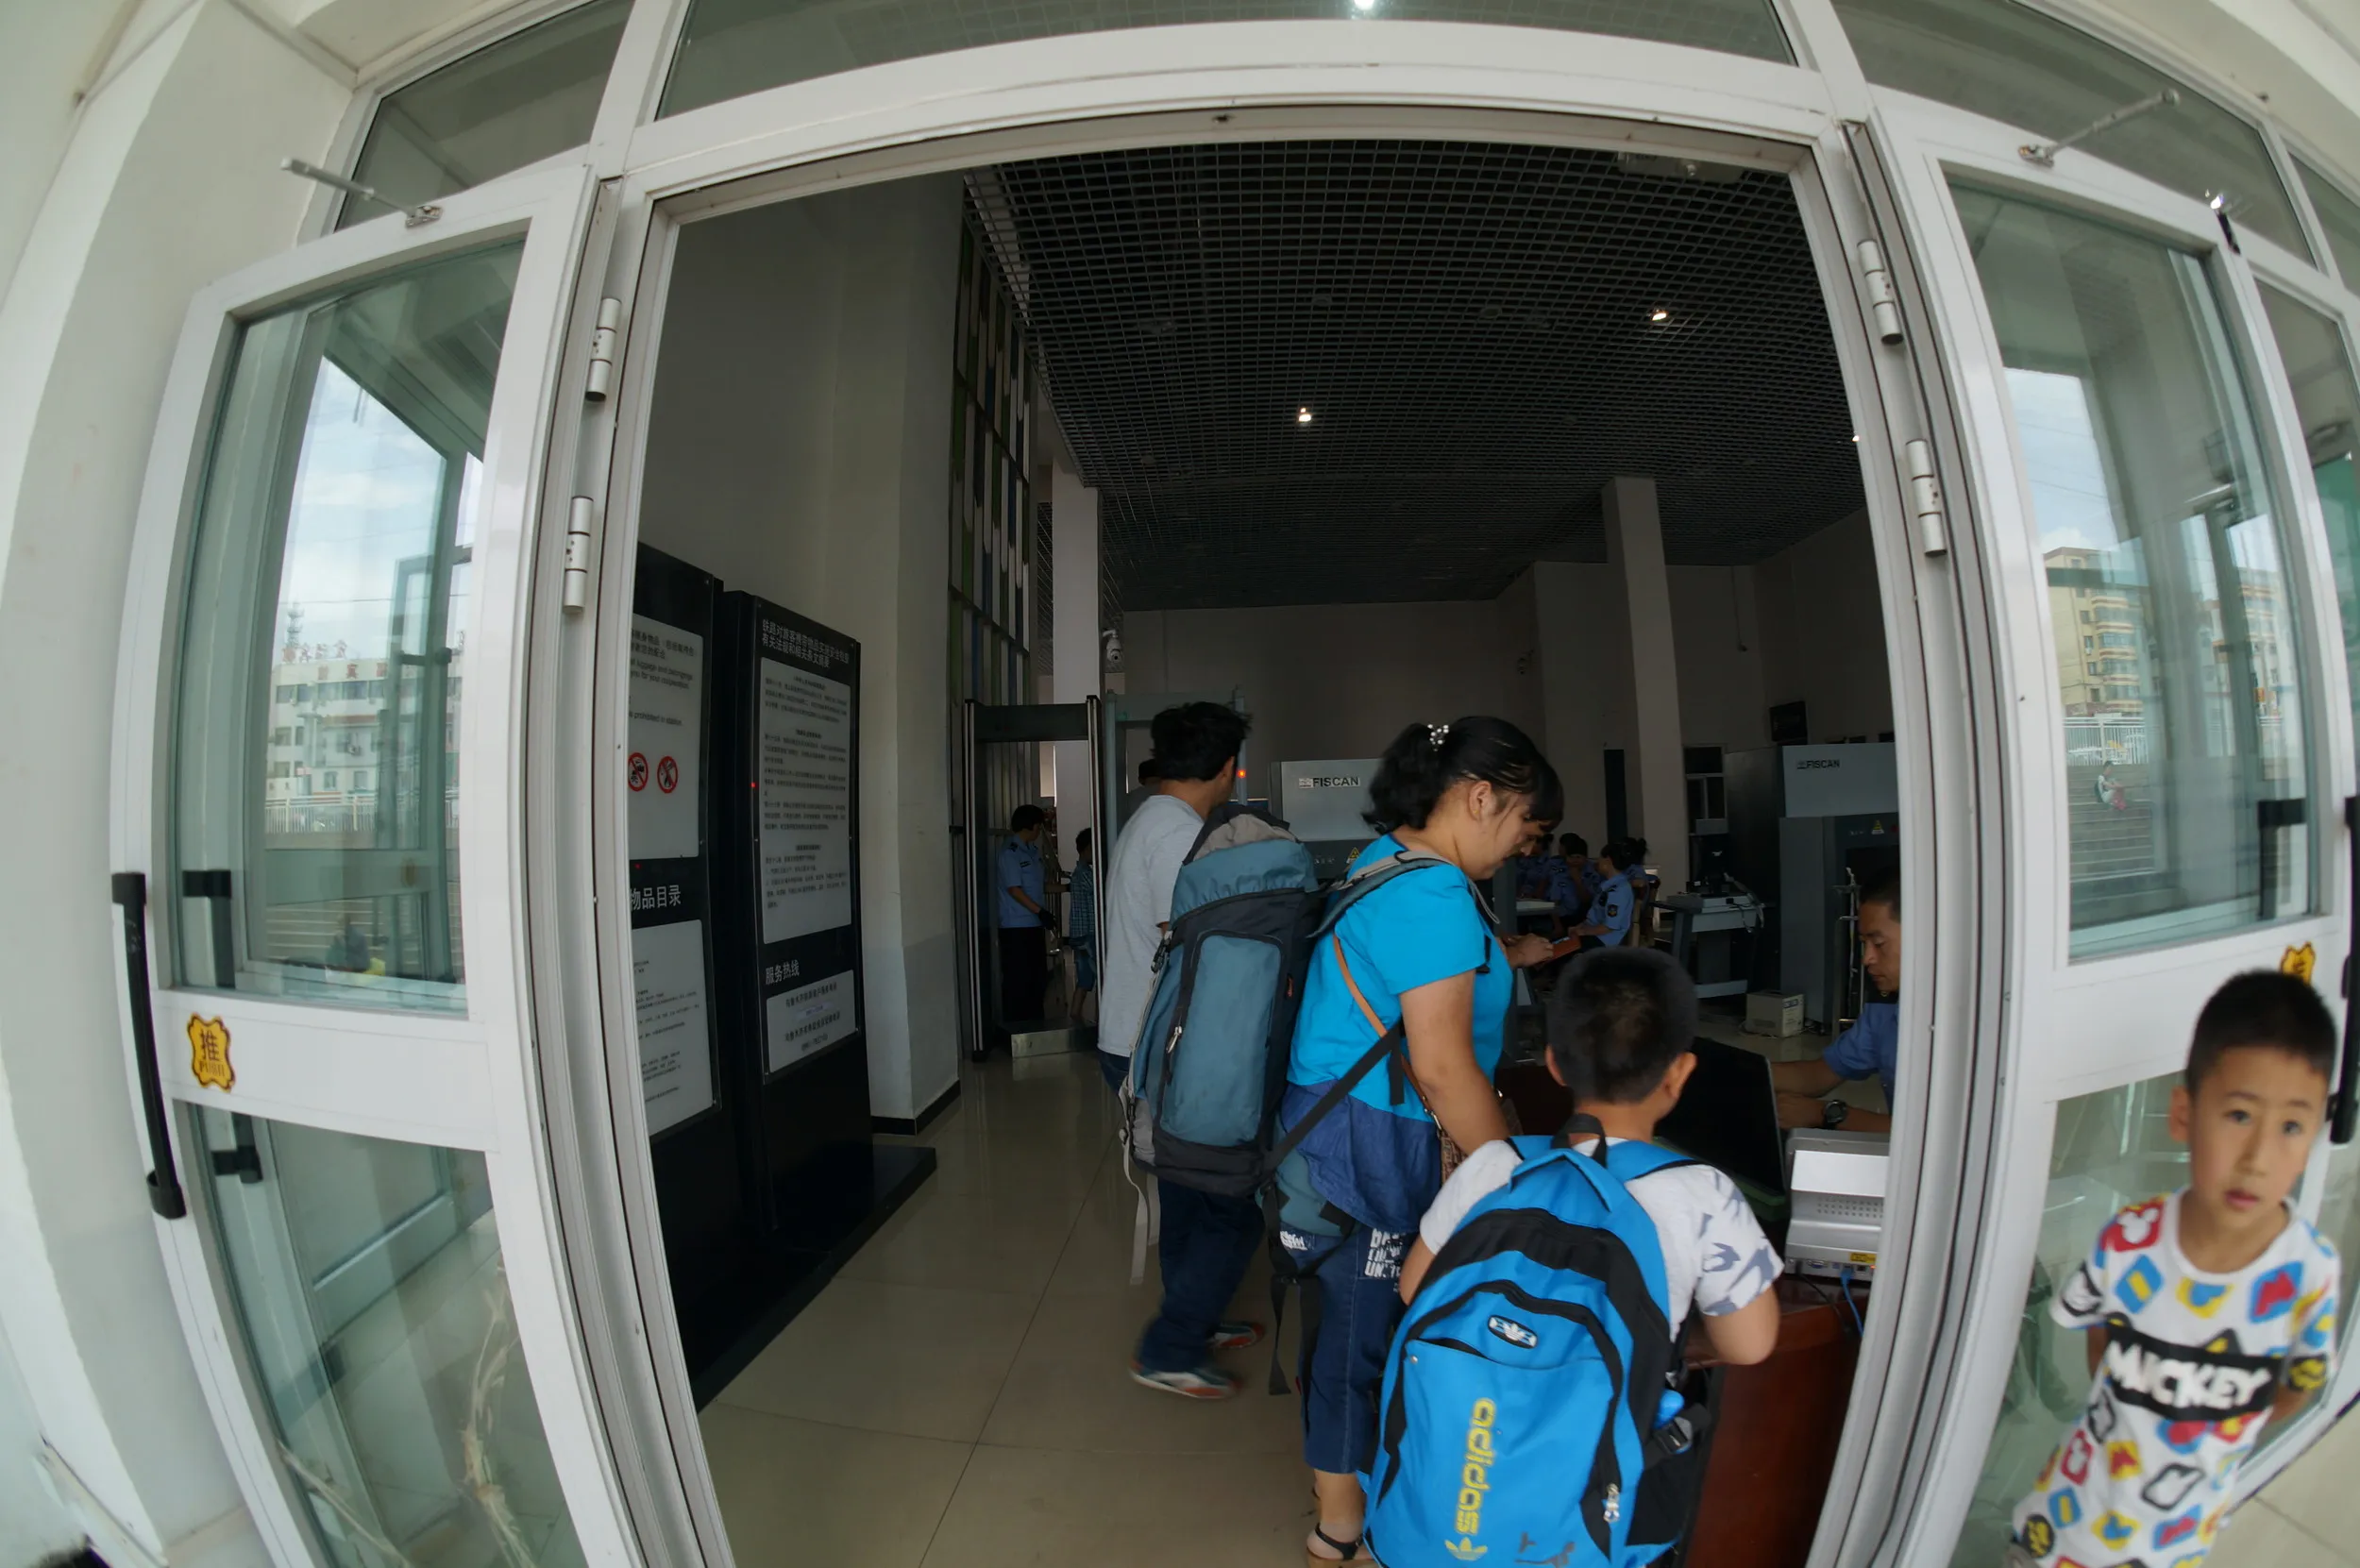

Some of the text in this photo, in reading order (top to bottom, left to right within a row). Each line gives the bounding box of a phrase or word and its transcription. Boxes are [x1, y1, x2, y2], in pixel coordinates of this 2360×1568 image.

[1806, 760, 1841, 768] FISCAN
[1312, 777, 1359, 787] FISCAN
[631, 885, 682, 911] 物品目录
[766, 959, 801, 986] 服务热线
[200, 1029, 220, 1061] 推
[2107, 1340, 2271, 1409] MICKEY
[1455, 1397, 1497, 1535] adidas
